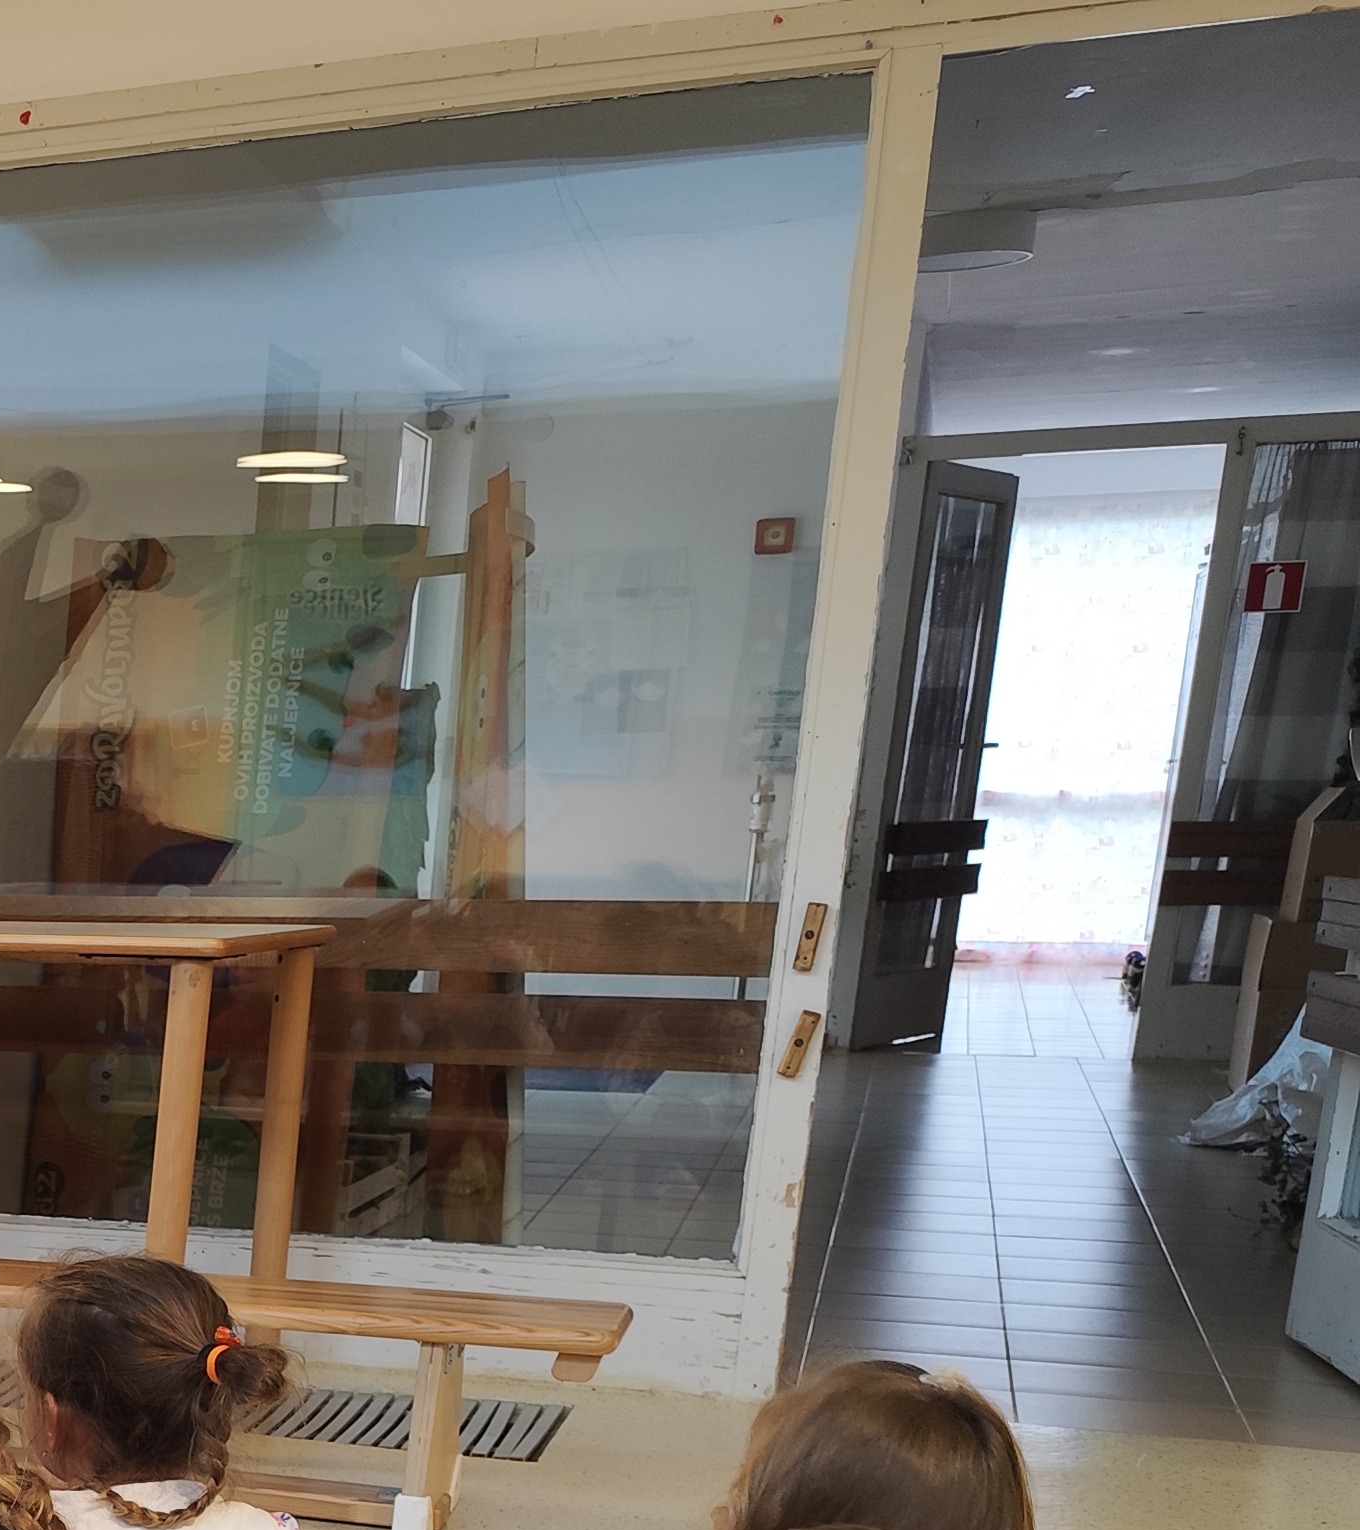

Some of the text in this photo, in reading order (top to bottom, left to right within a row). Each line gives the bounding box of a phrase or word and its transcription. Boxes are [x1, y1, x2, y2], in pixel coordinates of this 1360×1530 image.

[216, 659, 243, 764] KUPNJOM
[233, 621, 269, 801] OVIH PROIZVODA
[253, 607, 290, 815] DOBIVATE DODATNE
[278, 646, 306, 778] NALJEPNICE
